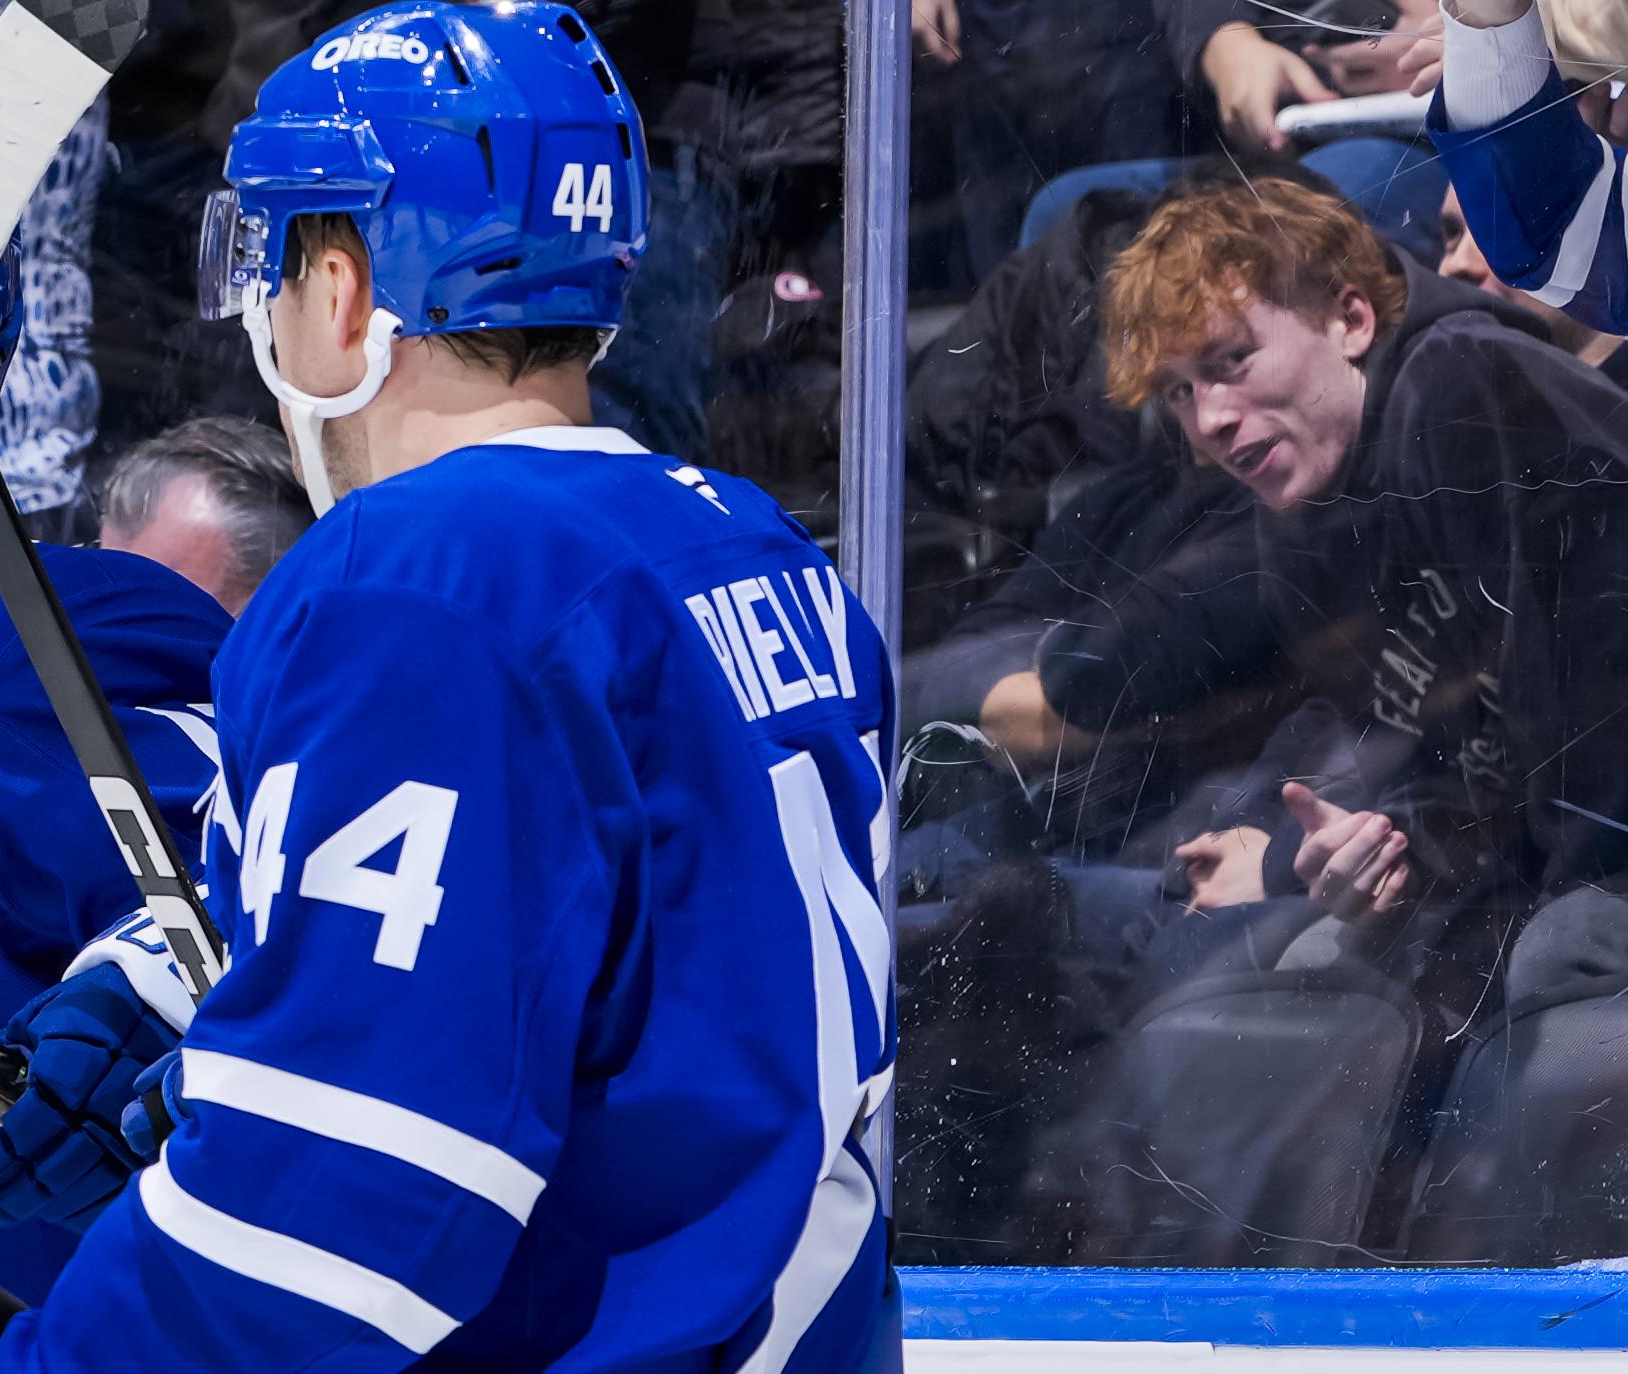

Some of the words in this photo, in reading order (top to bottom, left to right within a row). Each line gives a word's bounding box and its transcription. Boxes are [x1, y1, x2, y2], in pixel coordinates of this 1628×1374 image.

[311, 32, 430, 71] OREO
[551, 162, 614, 233] 44
[89, 776, 220, 998] CC
[240, 761, 459, 972] 44
